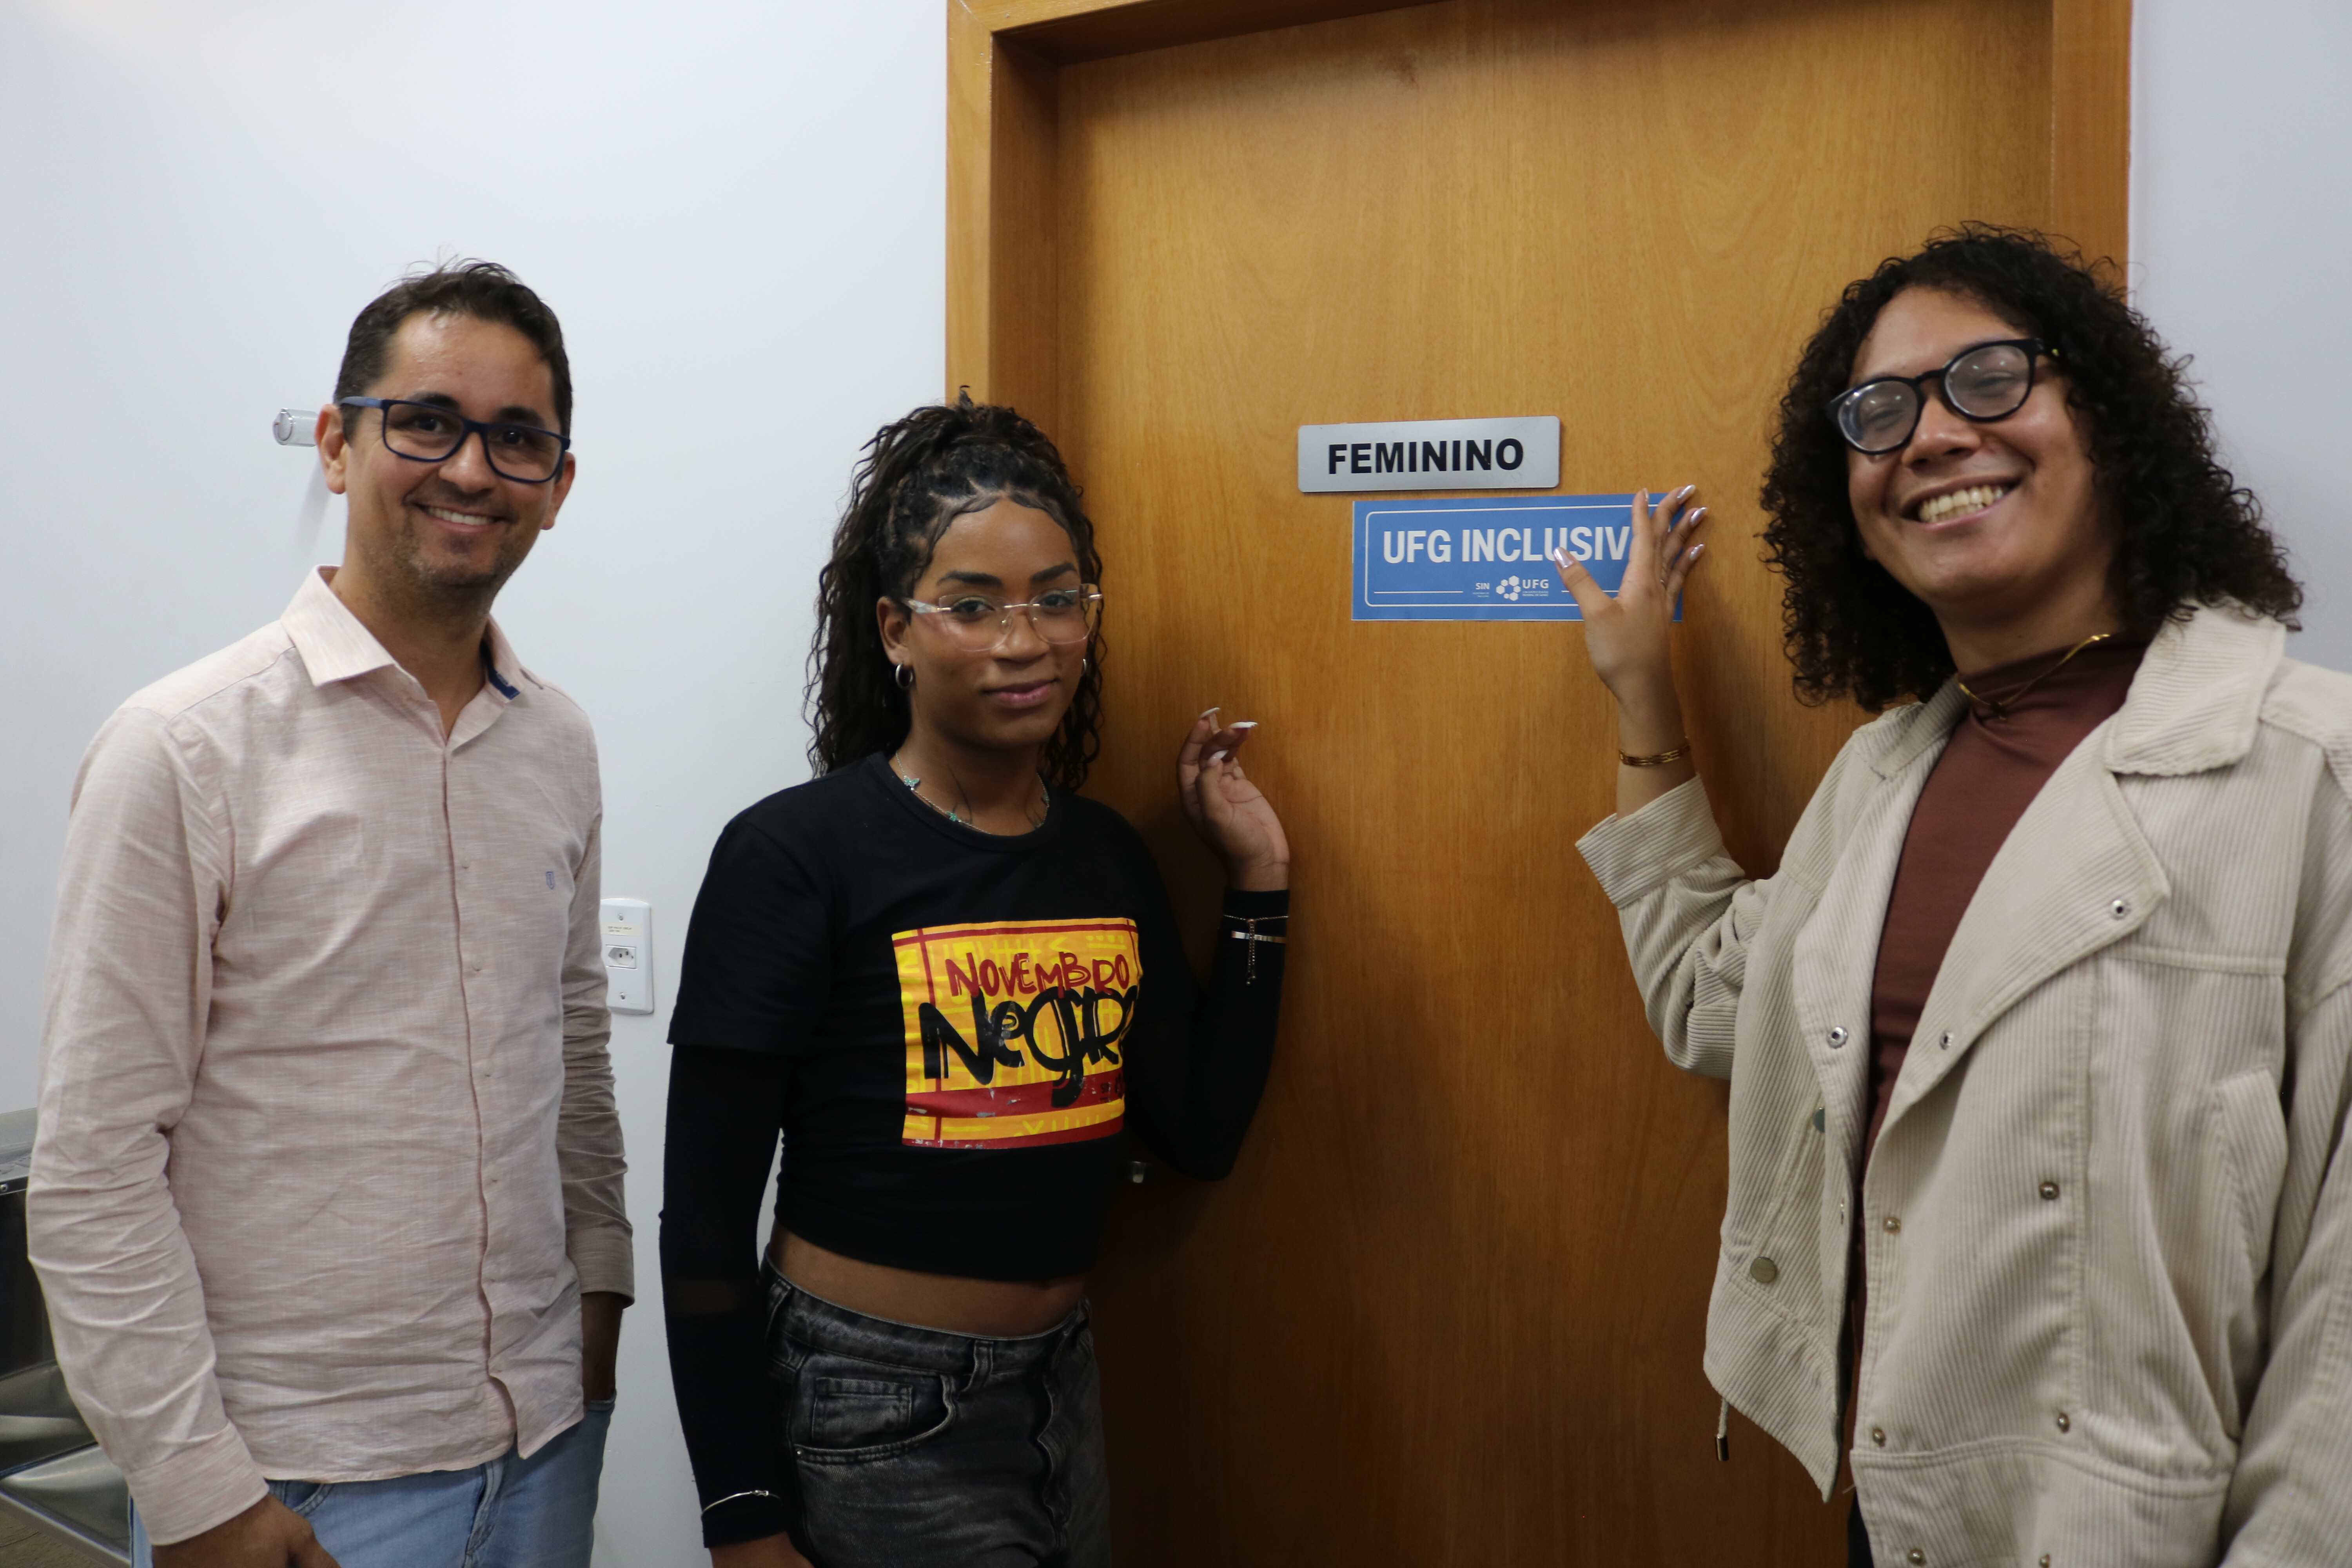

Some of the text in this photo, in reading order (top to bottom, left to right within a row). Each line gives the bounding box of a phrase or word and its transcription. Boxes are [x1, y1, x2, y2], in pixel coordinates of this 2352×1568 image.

[1329, 439, 1523, 474] FEMININO
[1384, 526, 1631, 563] UFG INCLUSIV
[1522, 579, 1549, 589] UFG
[945, 952, 1130, 998] NOVEMBRO
